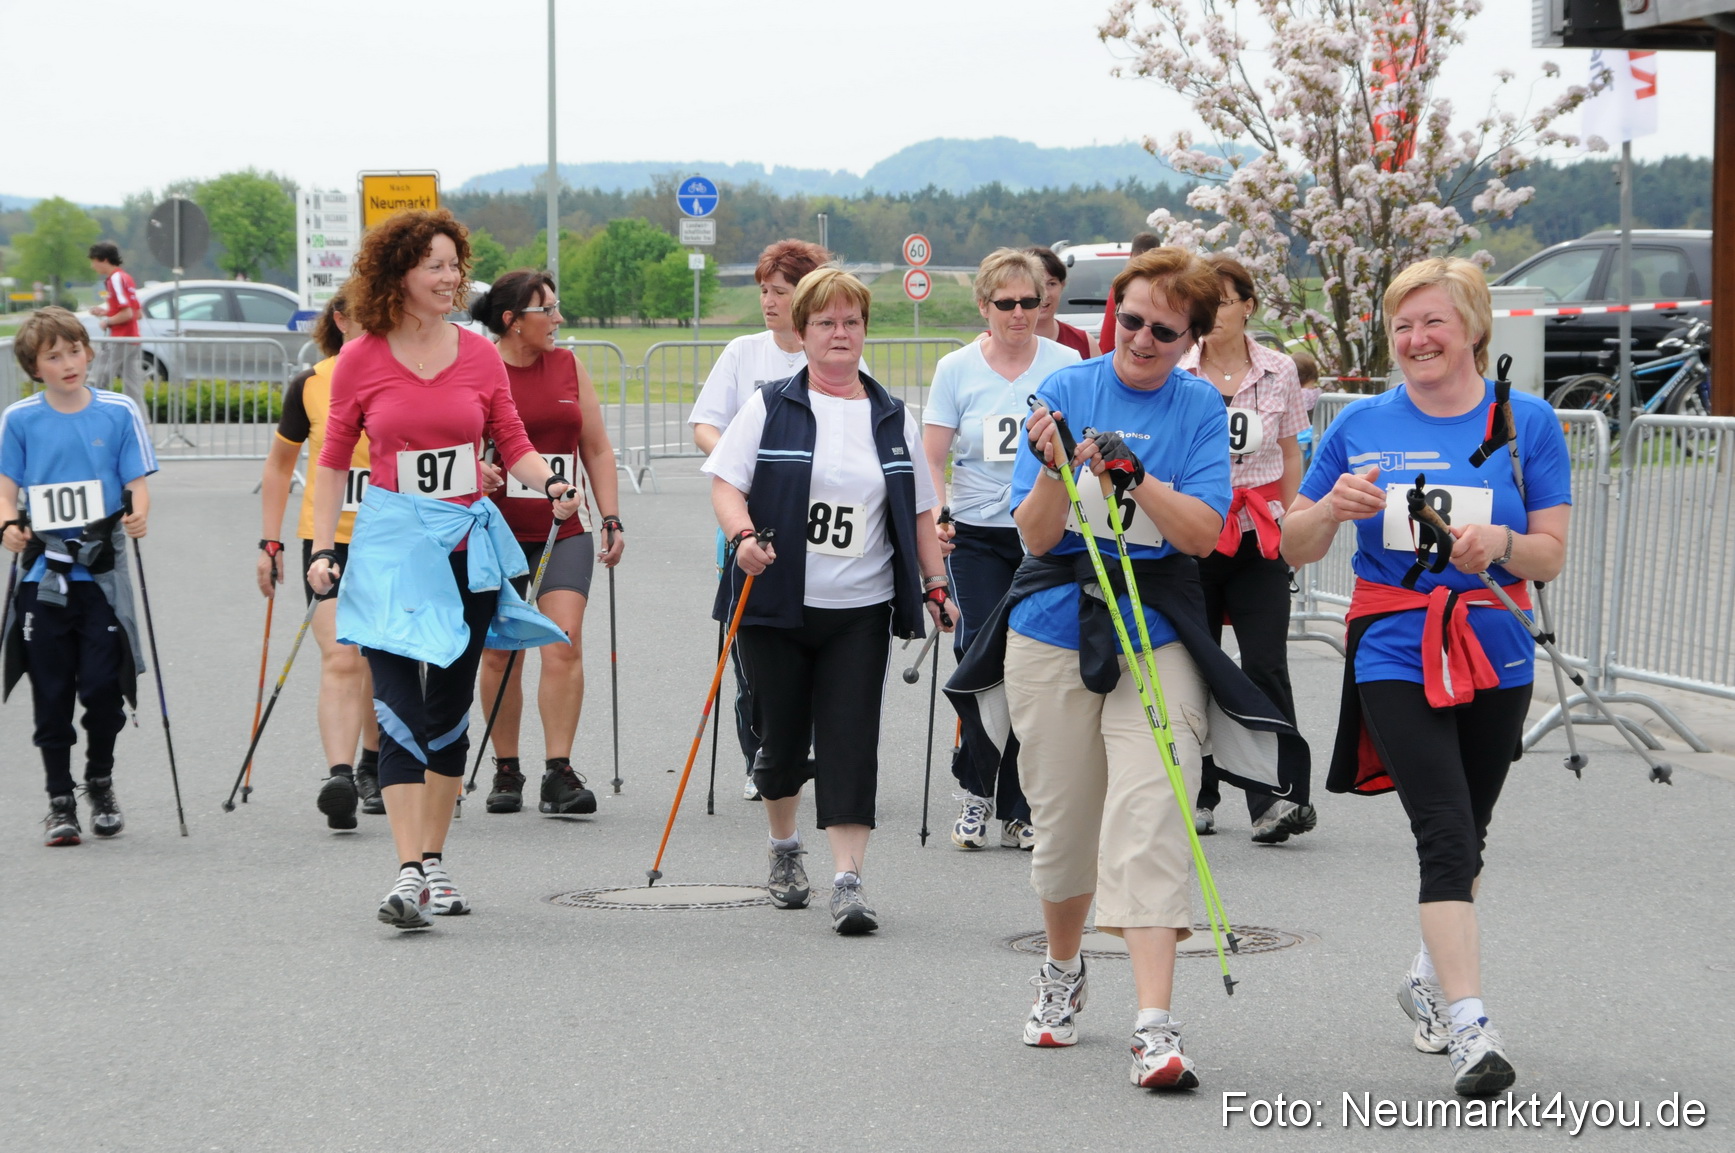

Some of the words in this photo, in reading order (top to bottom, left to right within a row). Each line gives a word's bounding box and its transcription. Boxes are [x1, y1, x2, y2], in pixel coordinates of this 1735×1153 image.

[369, 196, 431, 209] Neumarkt
[910, 243, 925, 258] 60
[998, 416, 1027, 455] 2
[416, 449, 457, 494] 97
[42, 485, 89, 524] 101
[806, 502, 854, 549] 85
